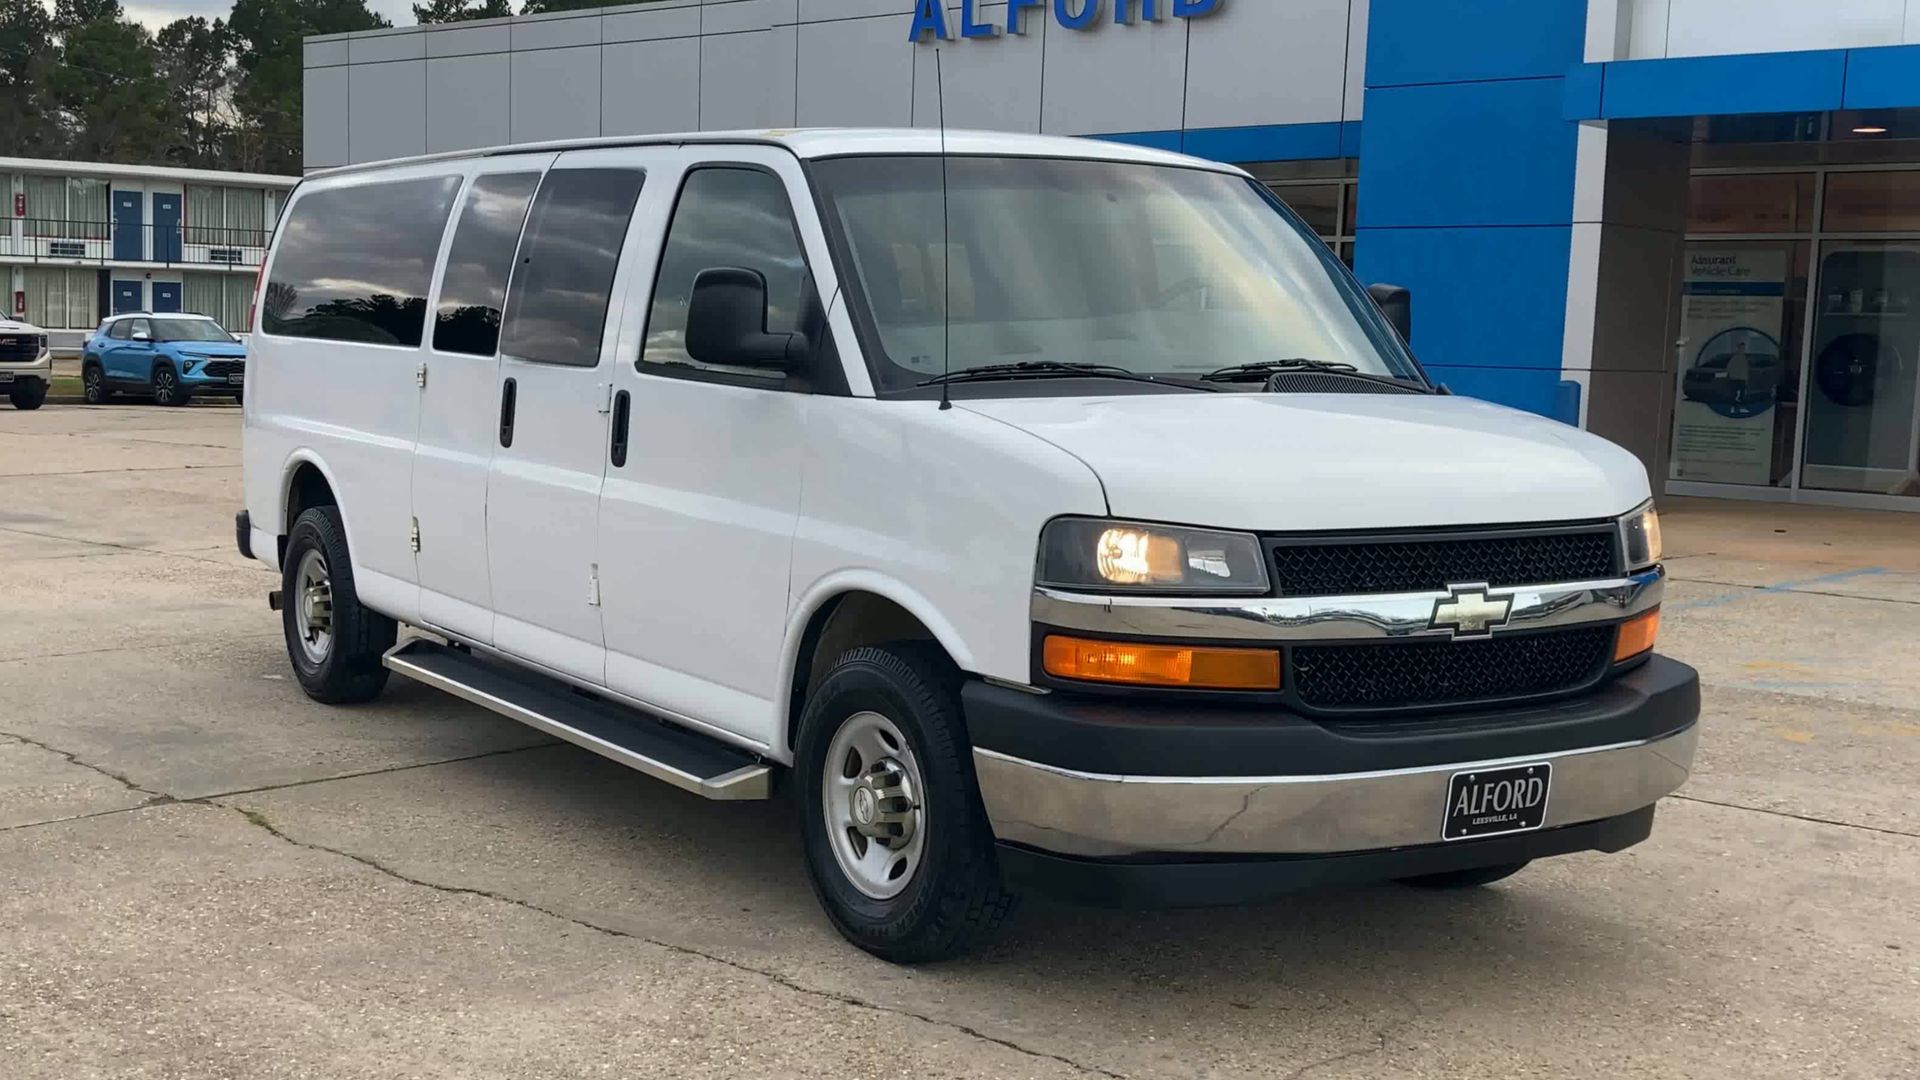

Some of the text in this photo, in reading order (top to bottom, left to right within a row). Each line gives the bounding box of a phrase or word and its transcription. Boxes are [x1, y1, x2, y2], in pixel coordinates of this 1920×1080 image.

[908, 0, 1220, 42] ALFO
[1691, 255, 1736, 265] Assurant
[1452, 777, 1544, 817] ALFORD
[1472, 812, 1518, 825] LEESVILLE, LA
